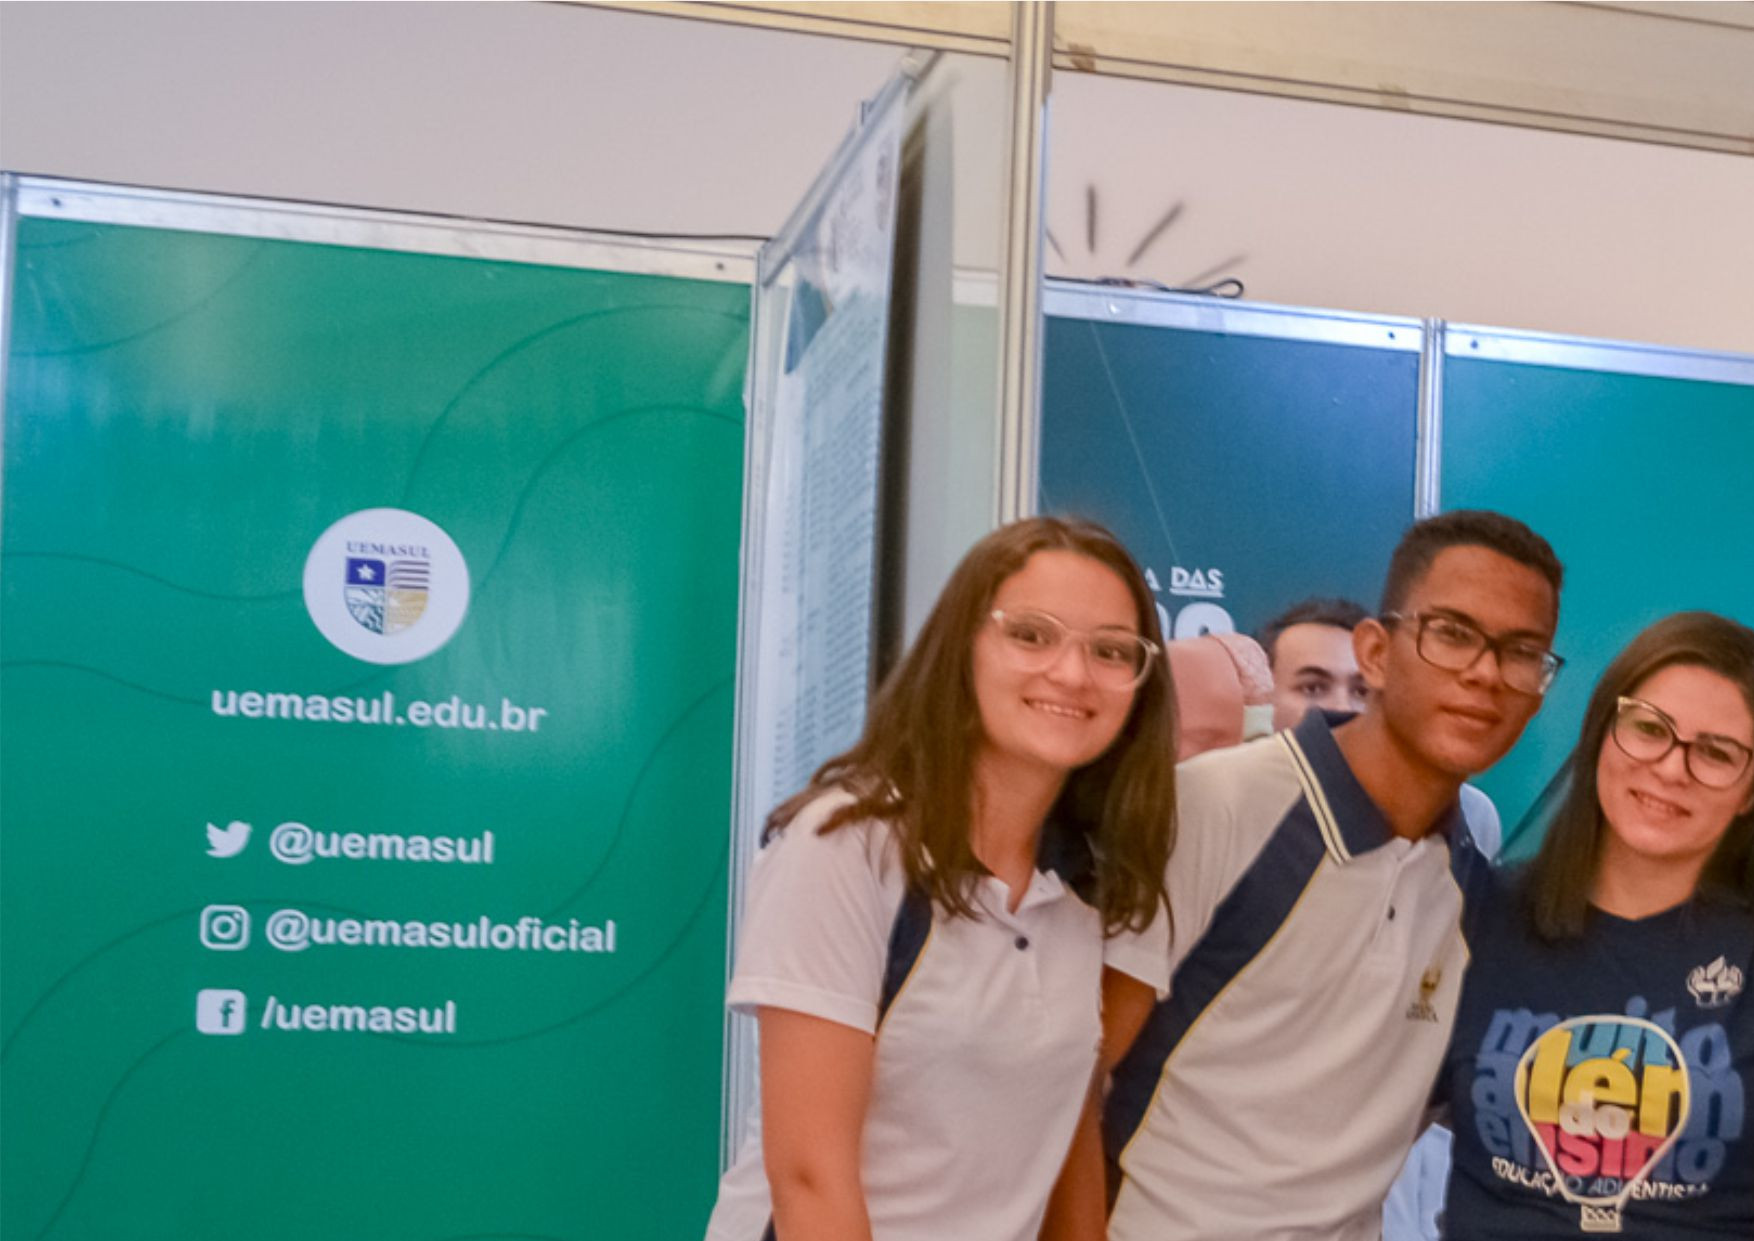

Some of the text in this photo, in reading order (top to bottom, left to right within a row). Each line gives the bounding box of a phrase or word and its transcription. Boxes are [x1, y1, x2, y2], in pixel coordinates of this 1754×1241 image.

[346, 540, 431, 558] UEMASUL
[1170, 566, 1224, 591] DAS
[212, 688, 548, 732] uemasul.edu.br
[269, 821, 494, 865] @uemasul
[265, 909, 616, 953] @uemasuloficial
[261, 996, 456, 1034] /uemasul
